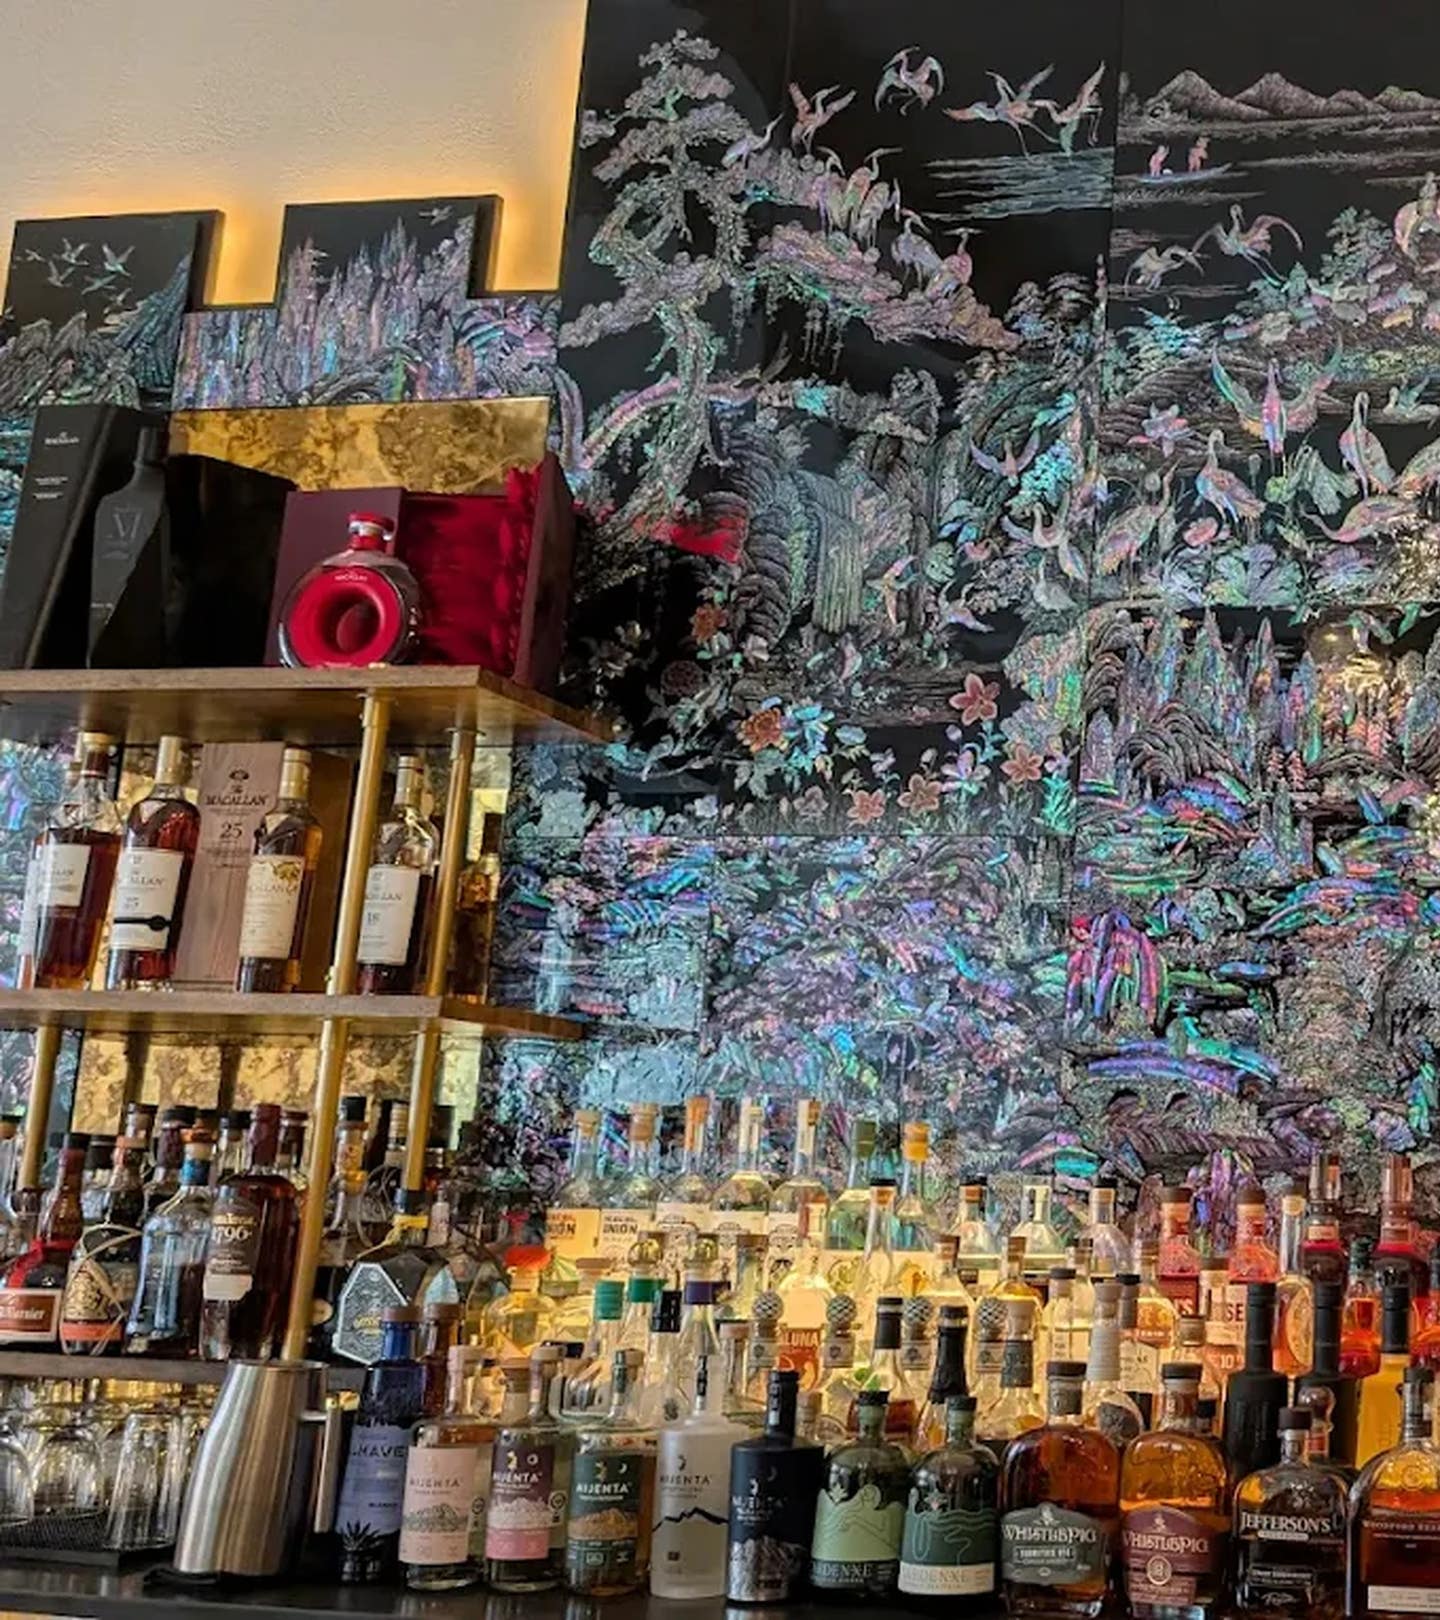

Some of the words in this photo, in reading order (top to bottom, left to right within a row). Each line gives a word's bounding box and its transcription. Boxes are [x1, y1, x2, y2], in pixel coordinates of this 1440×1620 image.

[206, 795, 269, 807] MACALLAN
[220, 822, 244, 840] 25
[1240, 1512, 1331, 1534] JEFFERSON'S
